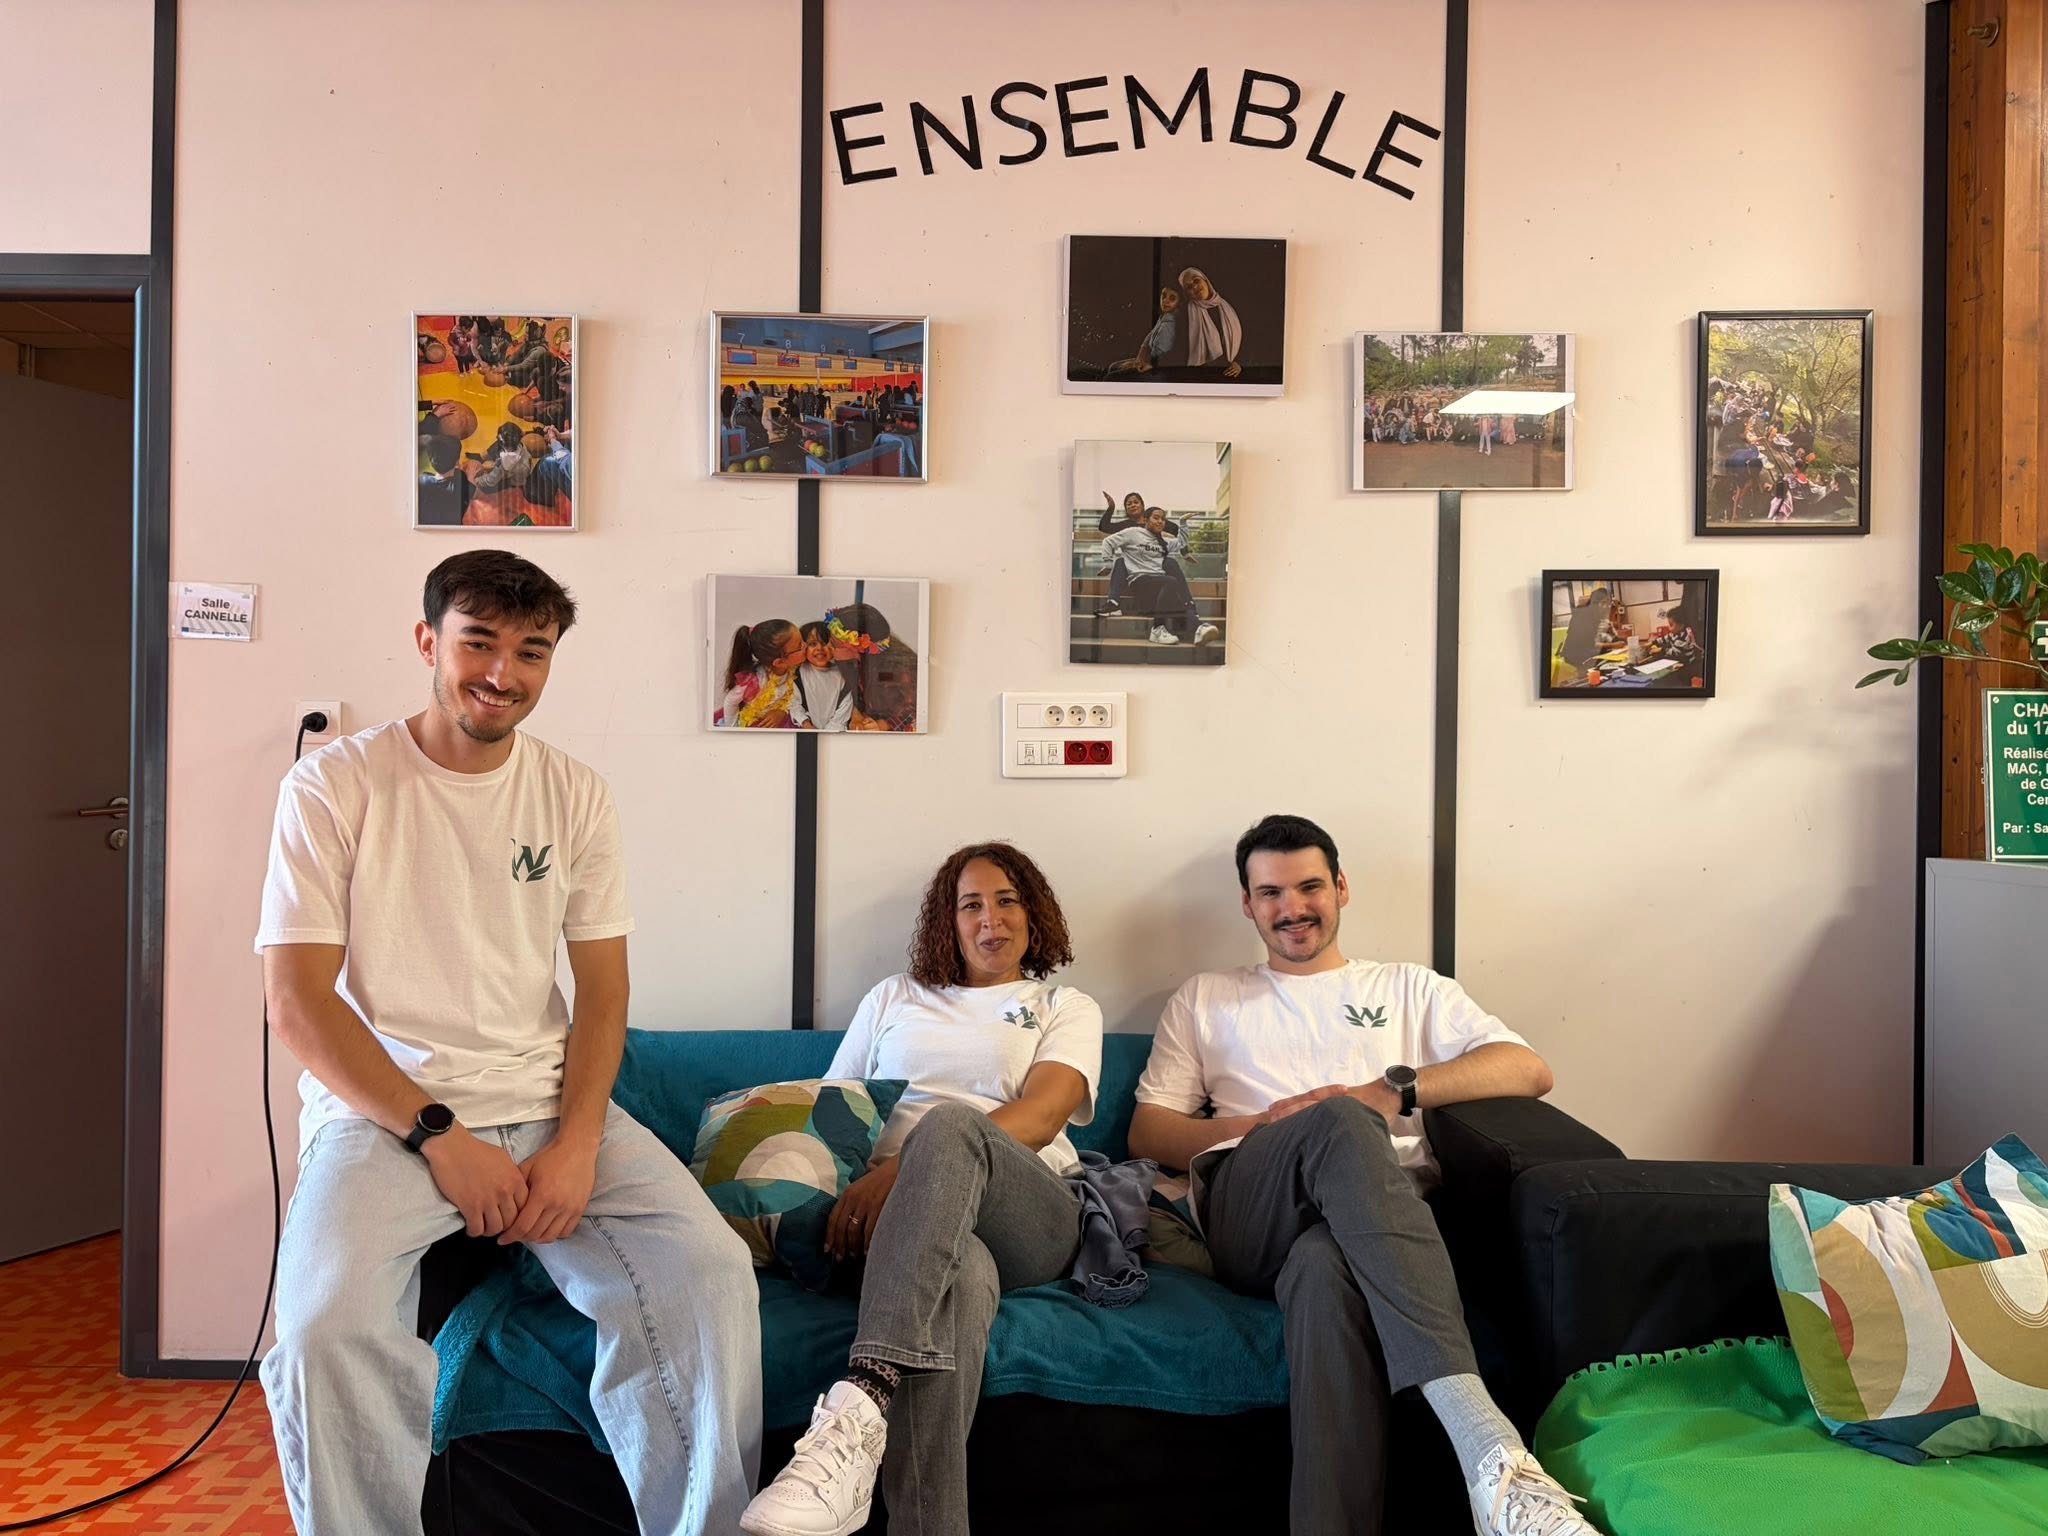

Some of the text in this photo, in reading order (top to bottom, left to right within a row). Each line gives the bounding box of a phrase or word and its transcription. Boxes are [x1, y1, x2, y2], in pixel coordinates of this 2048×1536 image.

[829, 66, 1441, 200] ENSEMBLE
[201, 598, 231, 609] Salle
[184, 609, 248, 623] CANNELLE
[2006, 720, 2028, 735] du
[2007, 762, 2042, 776] MAC,
[2021, 778, 2037, 790] de
[2002, 822, 2023, 833] Par
[2033, 822, 2048, 833] Sa
